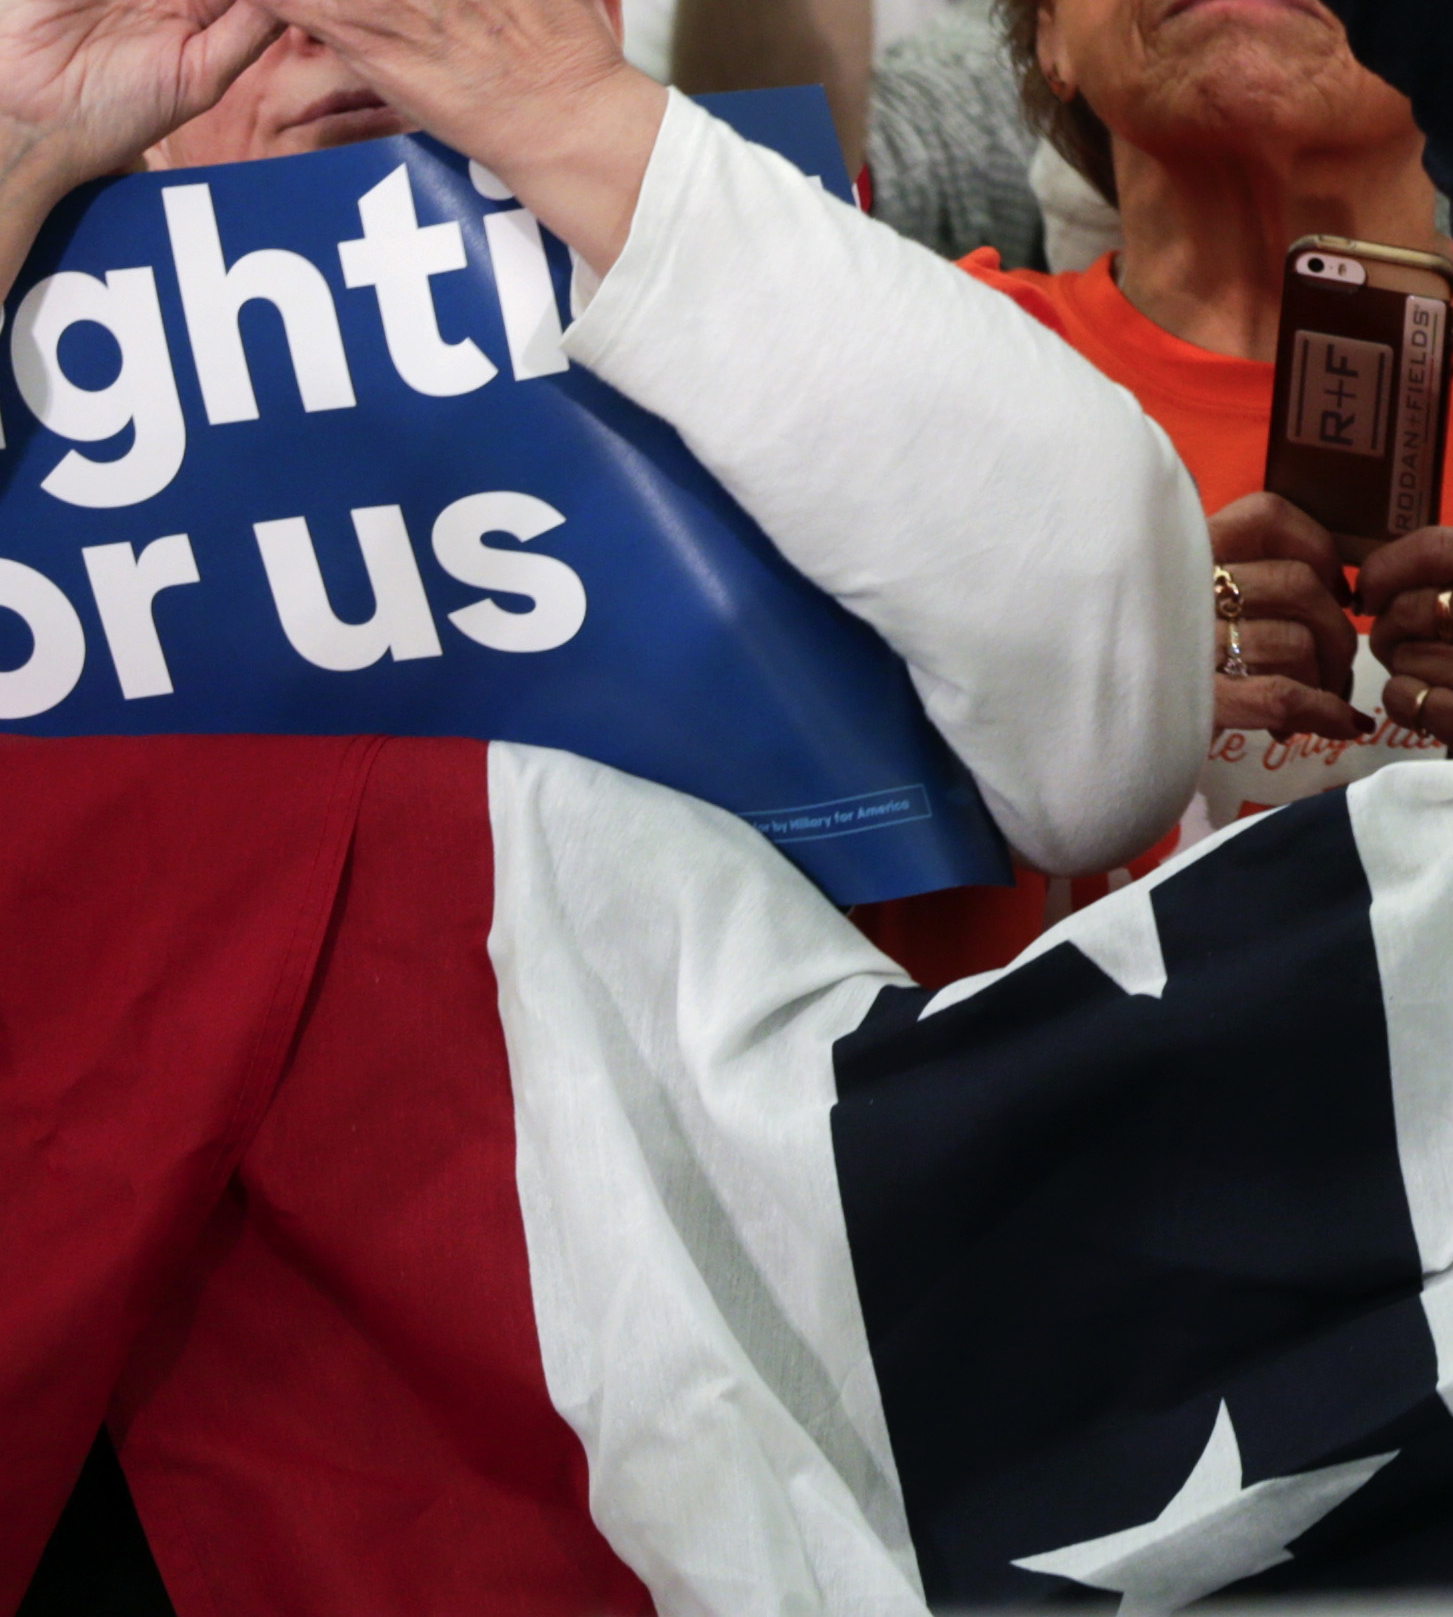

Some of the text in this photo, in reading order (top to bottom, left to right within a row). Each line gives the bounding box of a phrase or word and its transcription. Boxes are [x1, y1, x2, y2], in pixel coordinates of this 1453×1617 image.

[0, 161, 602, 509] ghti
[1319, 343, 1360, 447] R+F
[0, 490, 588, 720] or us
[789, 814, 832, 831] Hillary
[834, 810, 854, 825] for
[856, 799, 911, 820] America
